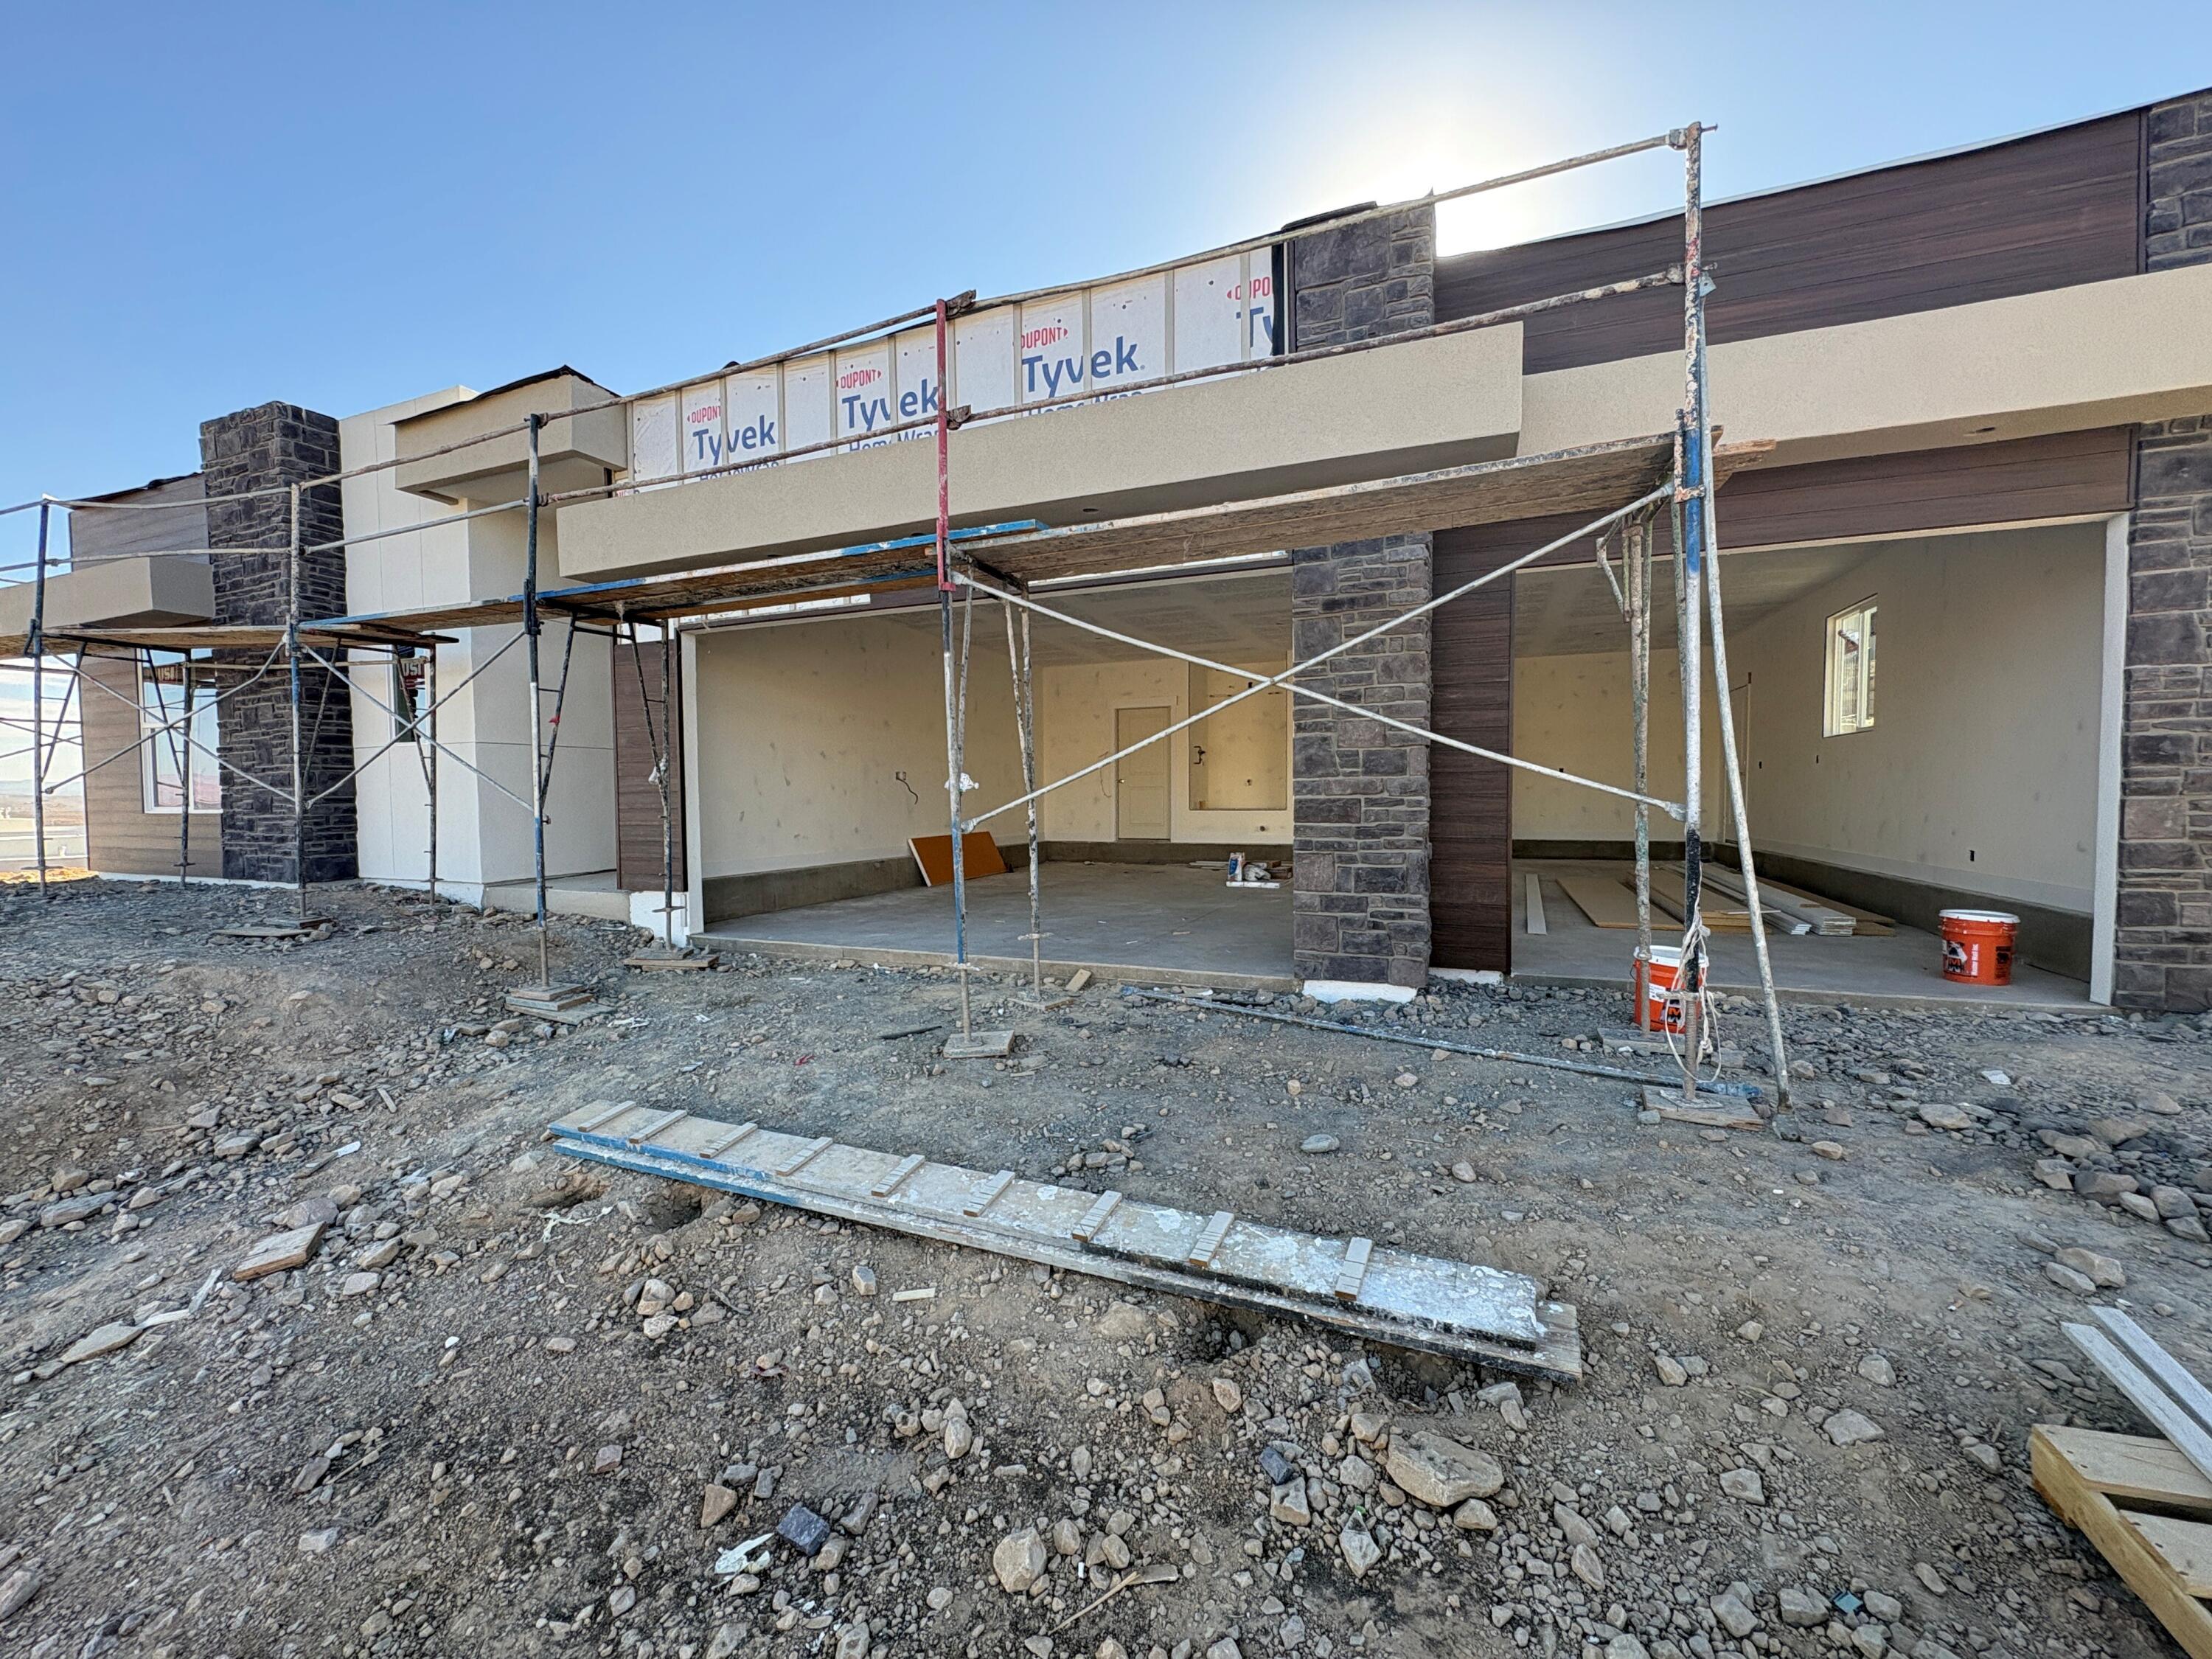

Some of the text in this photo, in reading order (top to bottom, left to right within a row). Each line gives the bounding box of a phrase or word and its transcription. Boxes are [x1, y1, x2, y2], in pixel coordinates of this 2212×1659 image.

[1021, 327, 1062, 349] DUPONT
[841, 369, 876, 389] DUPONT
[1022, 336, 1139, 398] Tyvek
[842, 378, 939, 432] Tyvek
[693, 414, 776, 466] Tyvek
